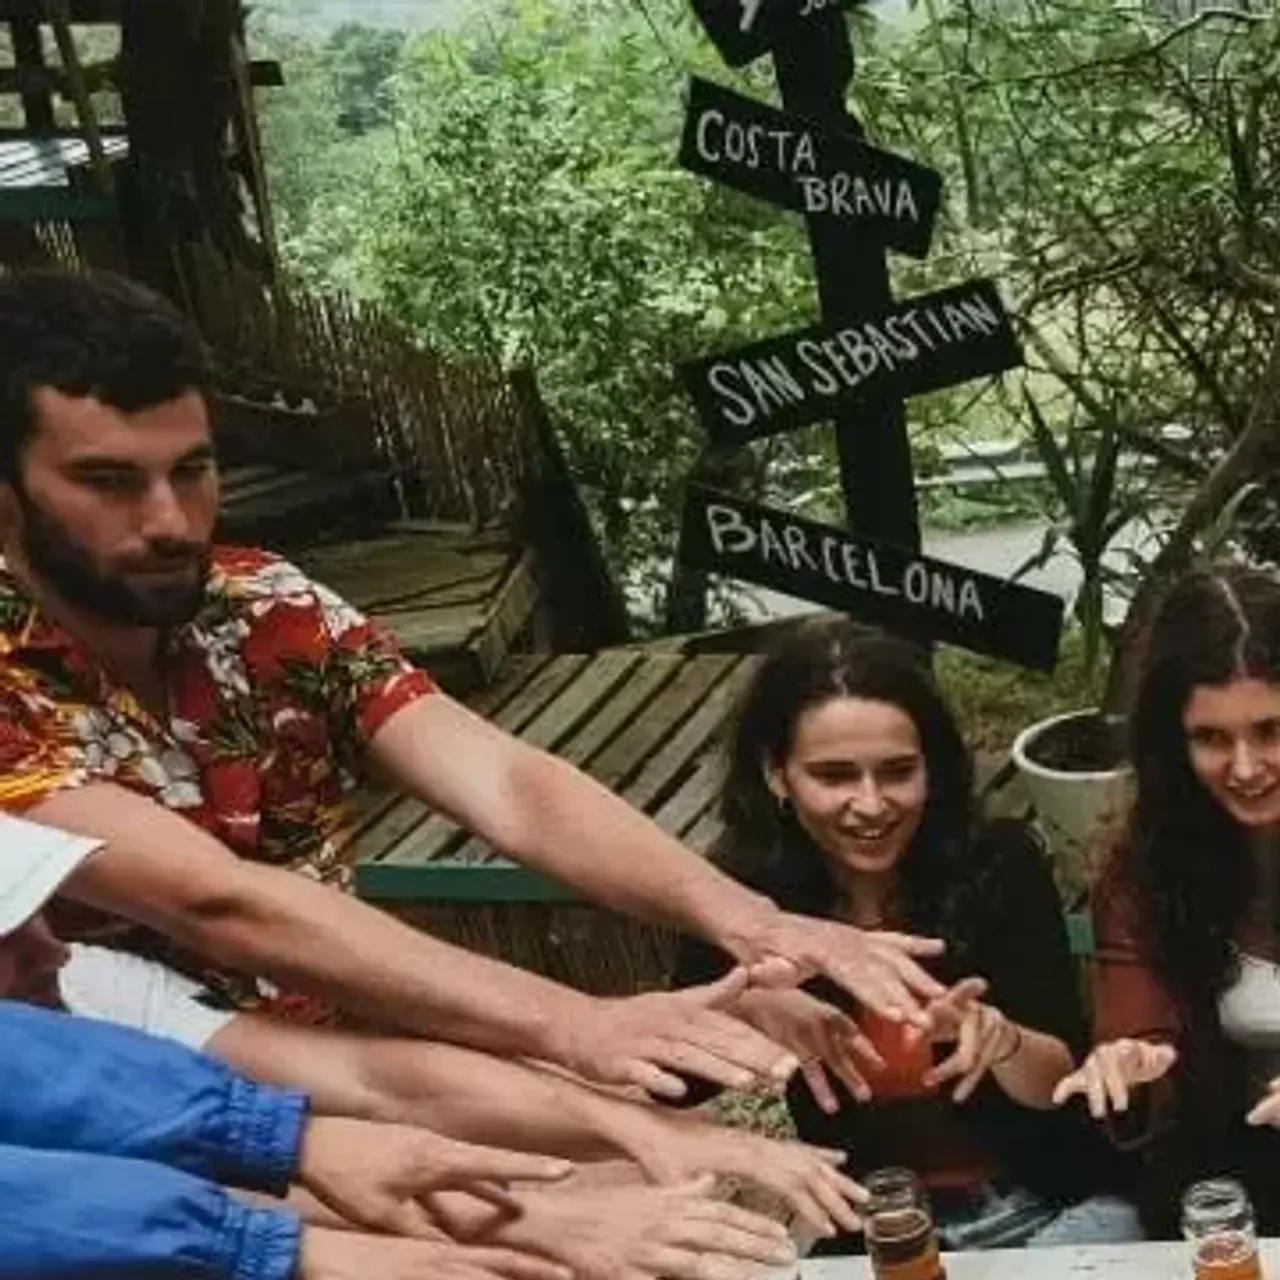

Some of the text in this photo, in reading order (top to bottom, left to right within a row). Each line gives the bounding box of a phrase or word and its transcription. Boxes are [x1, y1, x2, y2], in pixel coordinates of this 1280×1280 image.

[697, 109, 817, 171] COSTA
[799, 173, 917, 222] BRAVA
[708, 297, 1000, 425] SAN SEBASTIAN
[705, 504, 985, 621] BARCELONA
